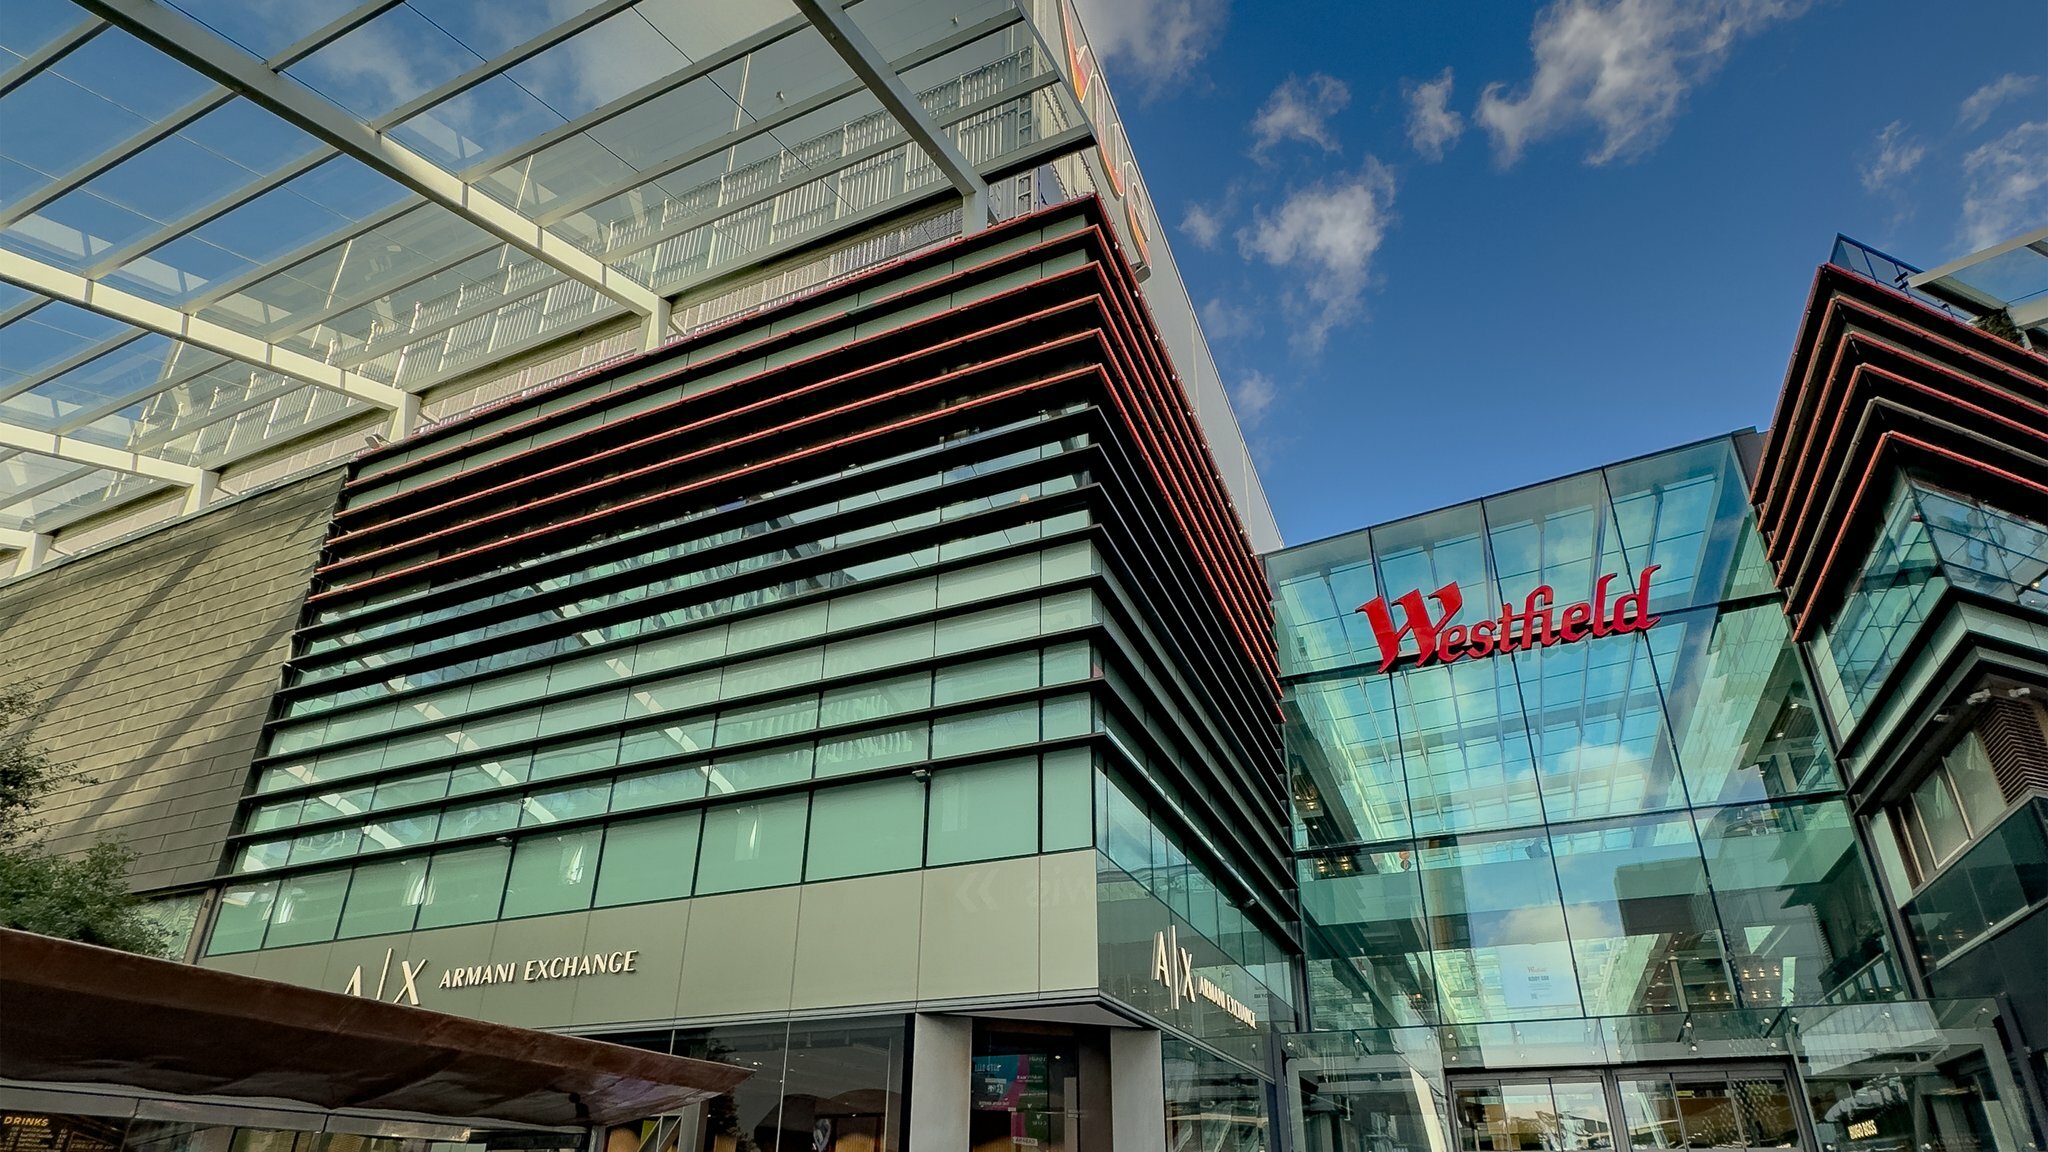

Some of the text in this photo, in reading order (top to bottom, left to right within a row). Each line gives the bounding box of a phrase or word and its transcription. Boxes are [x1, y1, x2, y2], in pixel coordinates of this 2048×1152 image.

[1355, 563, 1662, 674] Westfield
[439, 962, 516, 989] ARMANI
[523, 950, 639, 982] EXCHANGE
[1199, 976, 1226, 1009] ARMANI
[3, 1116, 49, 1127] DRINKS
